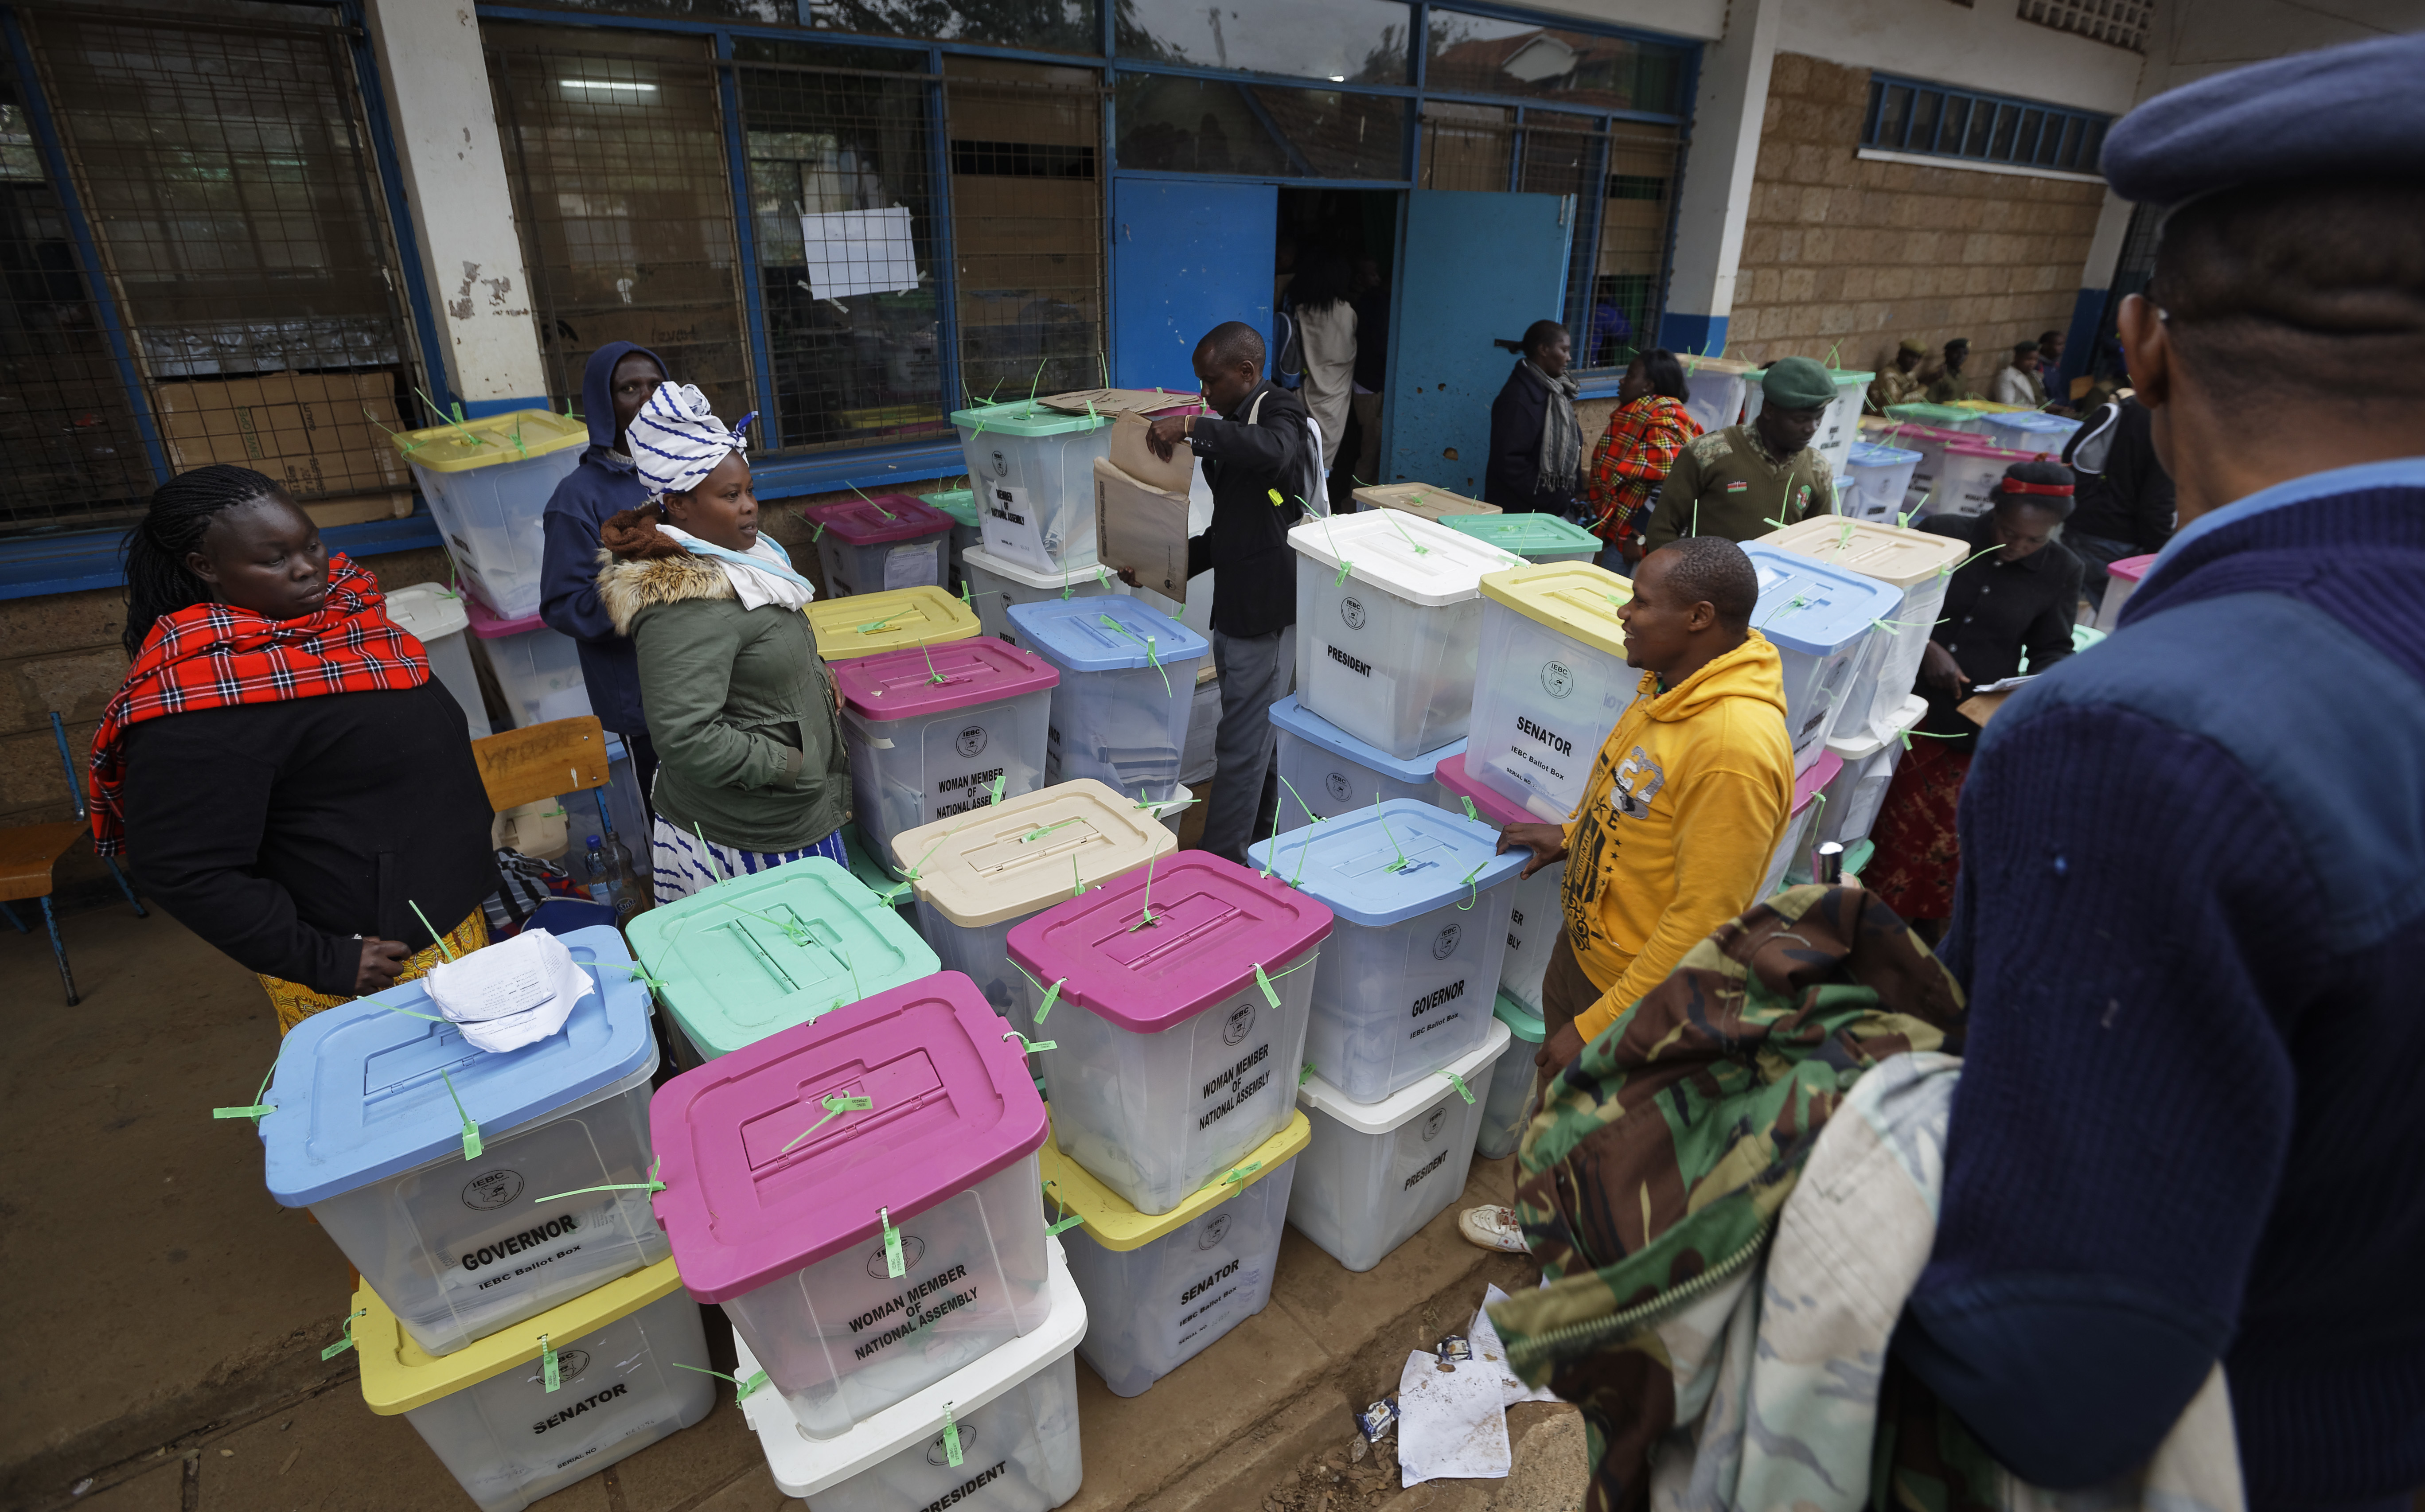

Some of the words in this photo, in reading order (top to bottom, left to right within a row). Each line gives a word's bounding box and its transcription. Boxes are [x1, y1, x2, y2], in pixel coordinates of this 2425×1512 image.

[996, 489, 1013, 503] MEMBER
[1004, 501, 1008, 510] OF
[991, 507, 1008, 521] NATIONAL
[1007, 512, 1024, 526] ASSEMBLY
[1347, 600, 1361, 610] IEBC
[999, 632, 1016, 647] PRESID
[1327, 644, 1371, 678] PRESIDENT
[1551, 663, 1567, 675] IEBC
[963, 729, 980, 737] IEBC
[1517, 716, 1571, 757] SENATOR
[1511, 745, 1527, 759] IEBC
[1529, 756, 1549, 772] Ballot
[1550, 768, 1564, 780] Box
[939, 775, 968, 793] WOMAN
[971, 768, 1003, 785] MEMBER
[1333, 774, 1346, 784] IEBC
[1506, 768, 1523, 780] SERIAL
[967, 787, 976, 798] OF
[937, 800, 970, 819] NATIONAL
[1442, 926, 1456, 936] IEBC
[1412, 979, 1464, 1017] GOVERNOR
[1232, 1007, 1249, 1022] IEBC
[1410, 1027, 1425, 1039] IEBC
[1427, 1018, 1445, 1031] Ballot
[1446, 1013, 1458, 1022] Box
[1203, 1067, 1234, 1099] WOMAN
[1236, 1044, 1269, 1077] MEMBER
[1232, 1077, 1242, 1093] OF
[1199, 1097, 1234, 1131] NATIONAL
[1236, 1070, 1270, 1107] ASSEMBLY
[1429, 1111, 1443, 1122] IEBC
[1404, 1150, 1448, 1191] PRESIDENT
[472, 1173, 504, 1188] IEBC
[1208, 1216, 1224, 1230] IEBC
[462, 1215, 578, 1271] GOVERNOR
[479, 1274, 511, 1290] IEBC
[515, 1257, 553, 1276] Ballot
[557, 1245, 581, 1259] Box
[1181, 1259, 1239, 1305] SENATOR
[849, 1295, 905, 1333] WOMAN
[907, 1264, 967, 1303] MEMBER
[1180, 1312, 1198, 1326] IEBC
[1200, 1296, 1221, 1313] Ballot
[1223, 1286, 1237, 1298] Box
[906, 1302, 922, 1317] OF
[854, 1321, 916, 1360] NATIONAL
[919, 1286, 978, 1327] ASSEMBLY
[1179, 1331, 1197, 1345] SERIAL
[533, 1383, 628, 1434] SENATOR
[557, 1454, 584, 1469] SERIAL
[920, 1461, 1006, 1512] RESIDENT
